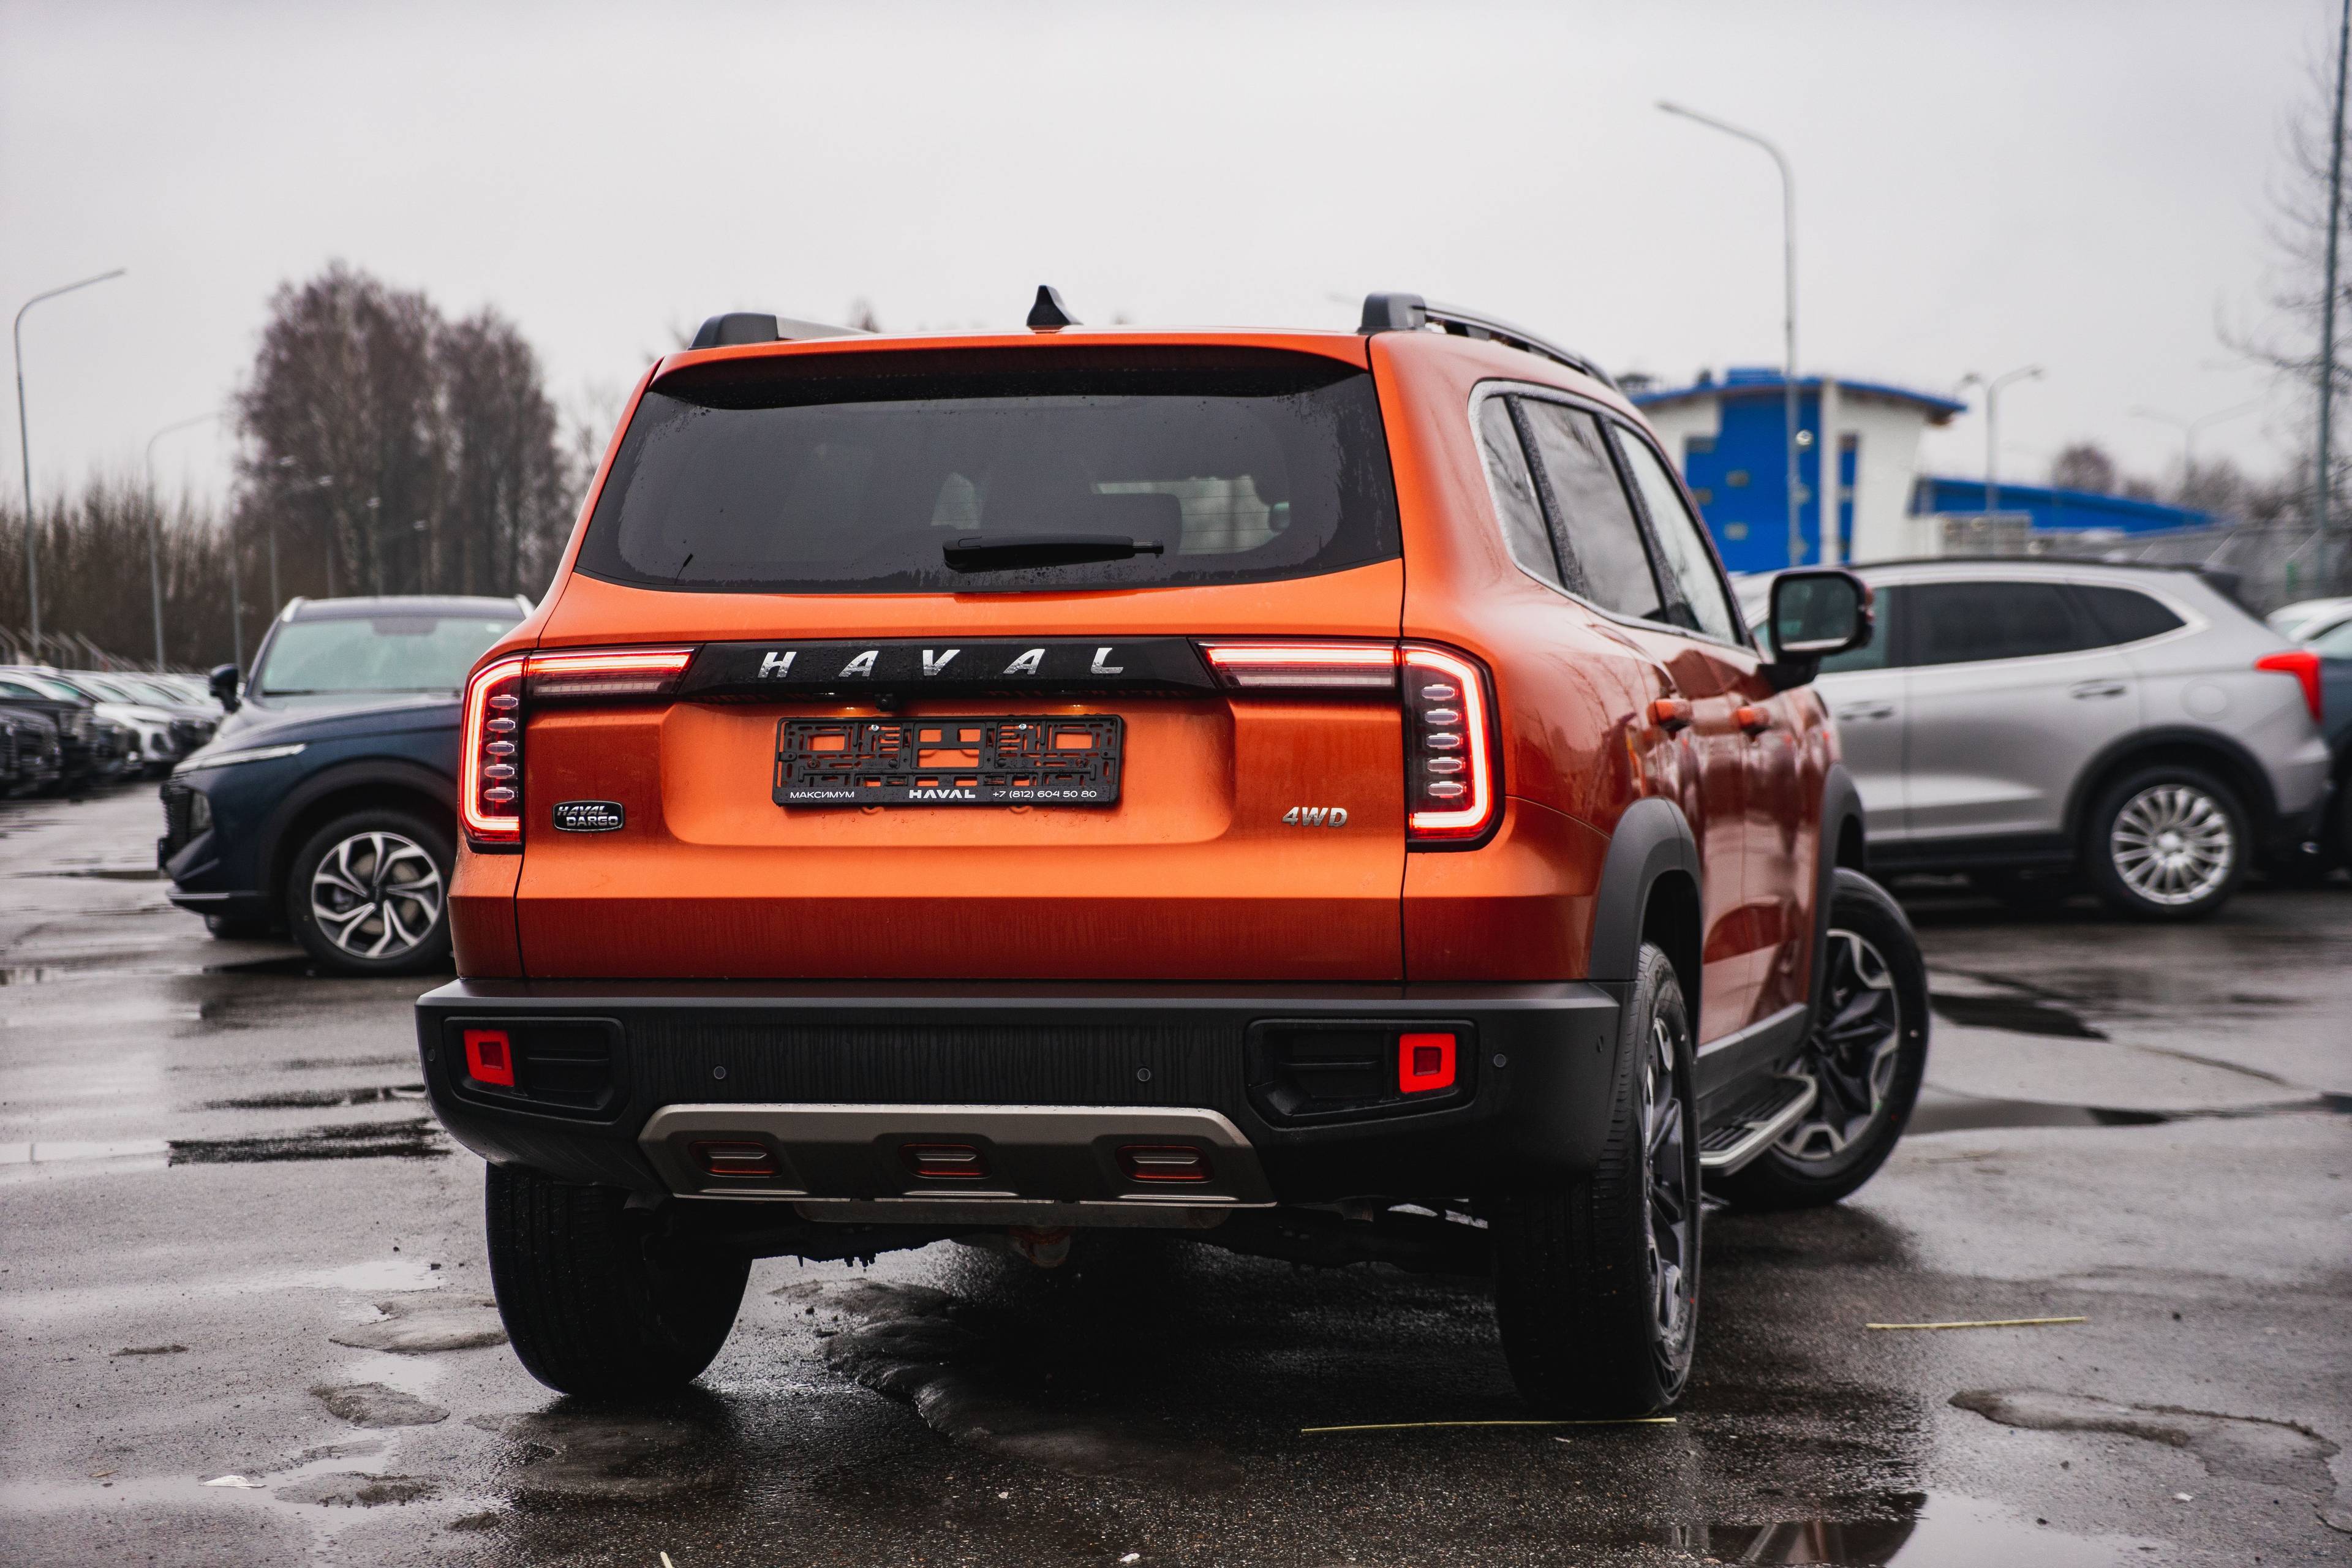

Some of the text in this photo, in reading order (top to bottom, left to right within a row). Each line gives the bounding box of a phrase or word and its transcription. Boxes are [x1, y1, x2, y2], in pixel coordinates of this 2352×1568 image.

[758, 647, 1124, 679] HAVAL
[908, 789, 976, 799] HAVAL
[1009, 790, 1034, 799] (812)
[557, 805, 609, 816] HAVAL
[566, 816, 618, 826] DARGO
[1282, 807, 1348, 827] 4WD
